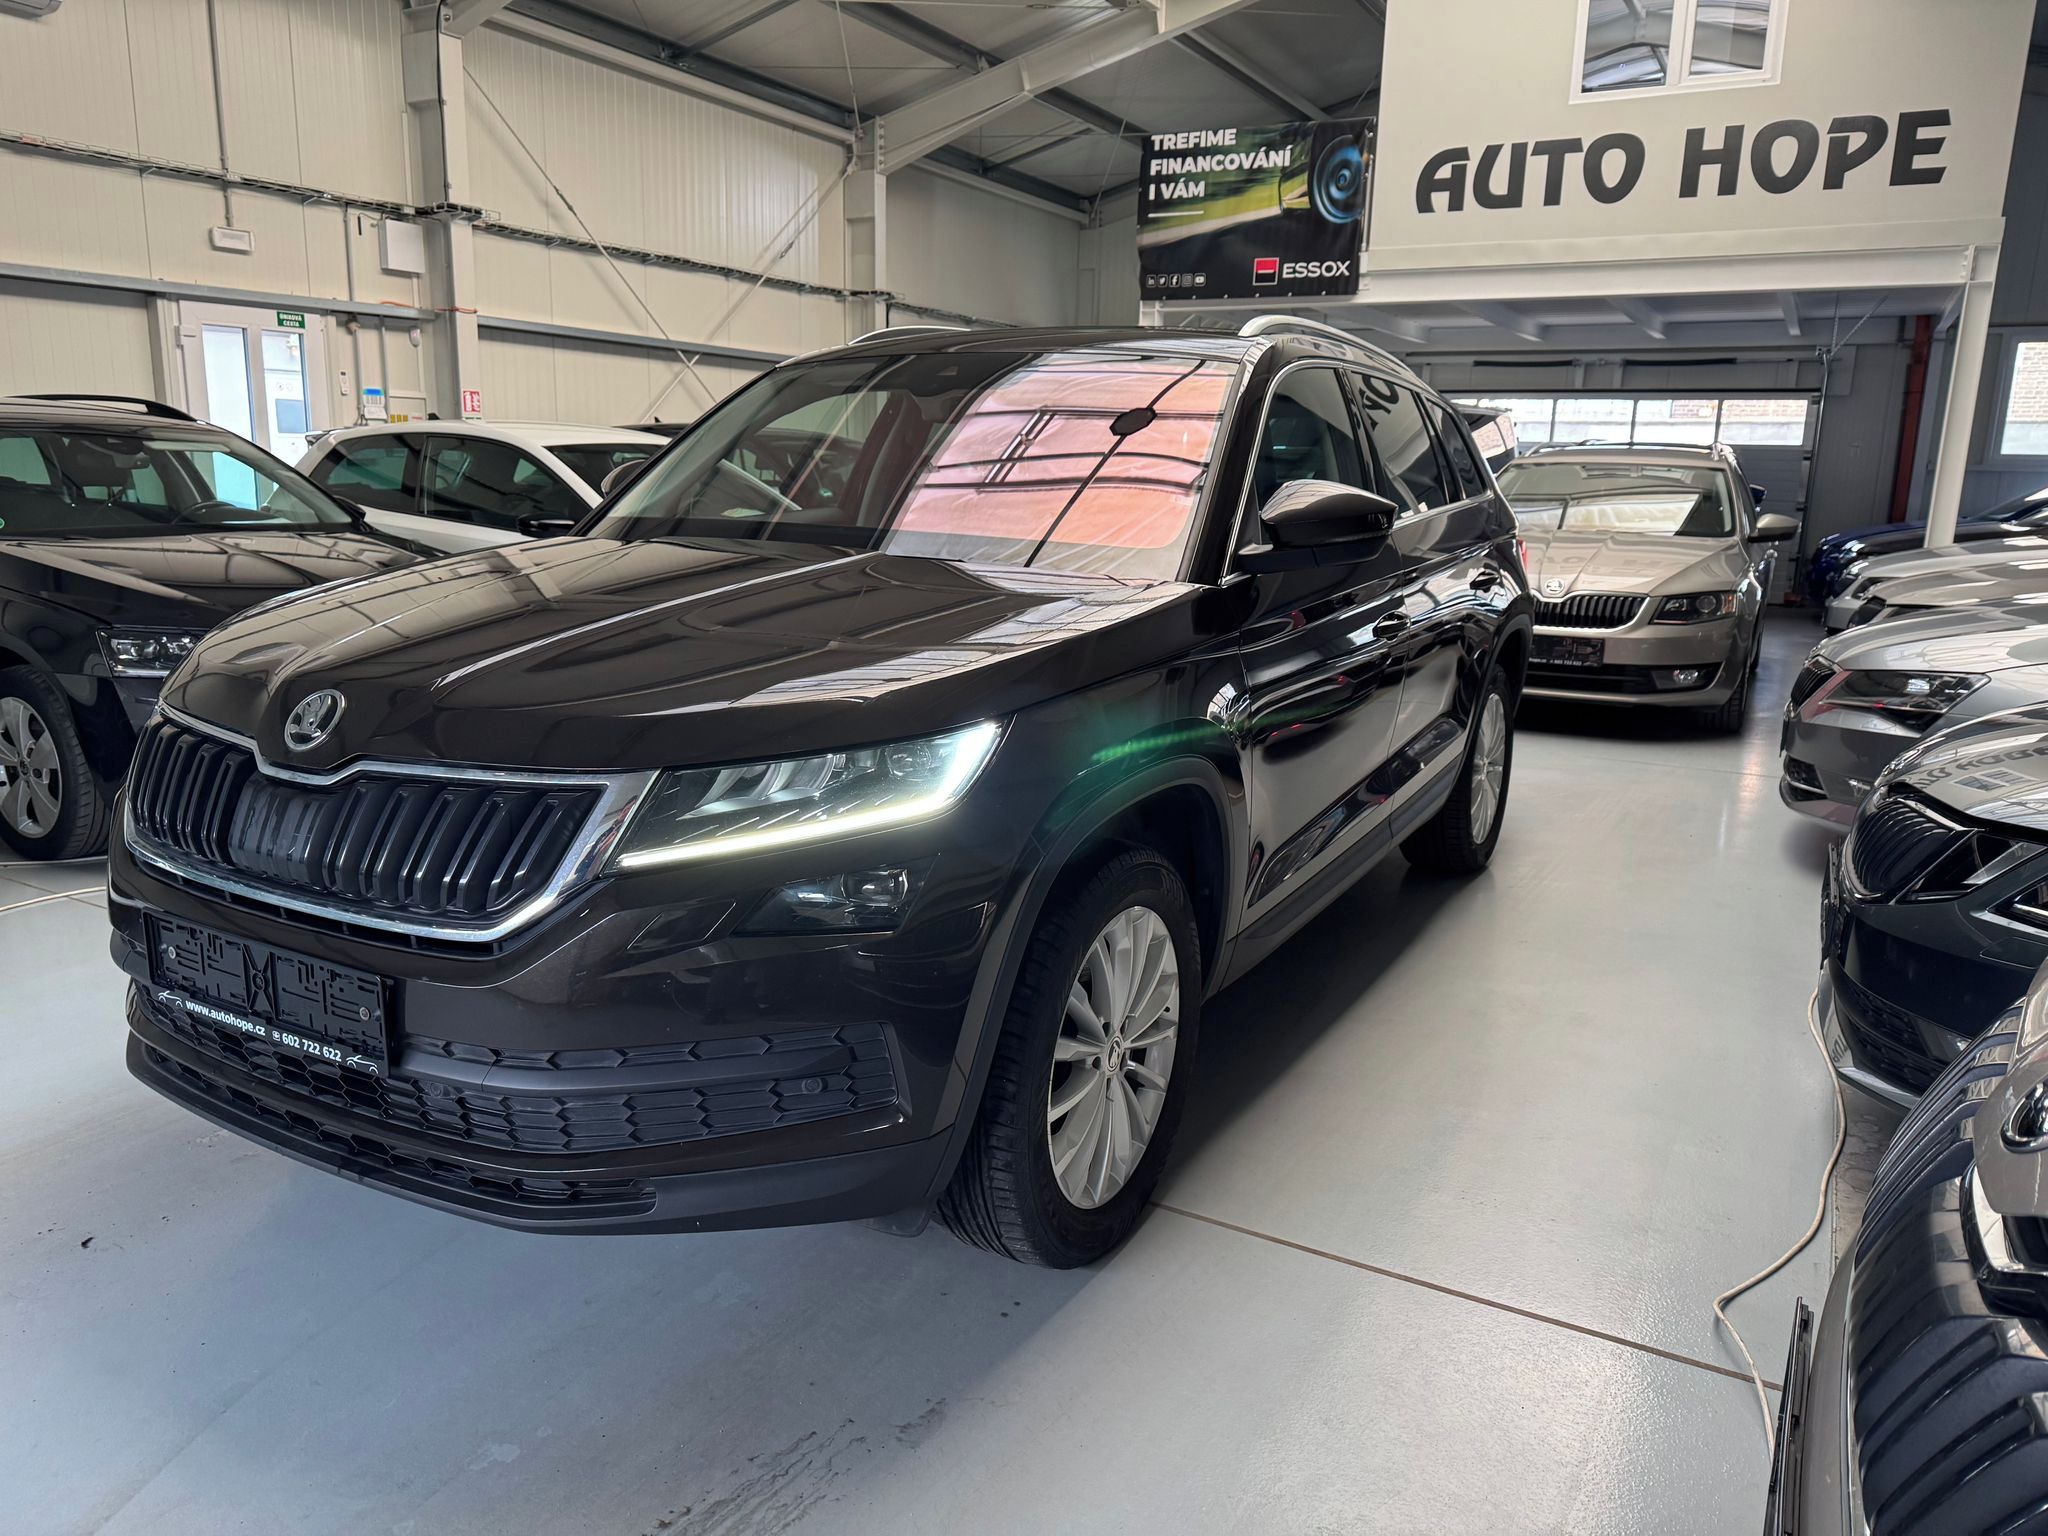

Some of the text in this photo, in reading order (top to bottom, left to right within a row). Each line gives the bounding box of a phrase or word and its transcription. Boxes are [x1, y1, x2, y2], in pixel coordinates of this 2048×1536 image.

[1151, 128, 1238, 151] TREFIME
[1150, 144, 1294, 177] FINANCOVÁNÍ
[1416, 108, 1952, 213] AUTO HOPE
[1149, 177, 1206, 201] I VÁM
[1282, 260, 1351, 279] ESSOX
[185, 1000, 342, 1062] www.autohope.cz 602 722 622
